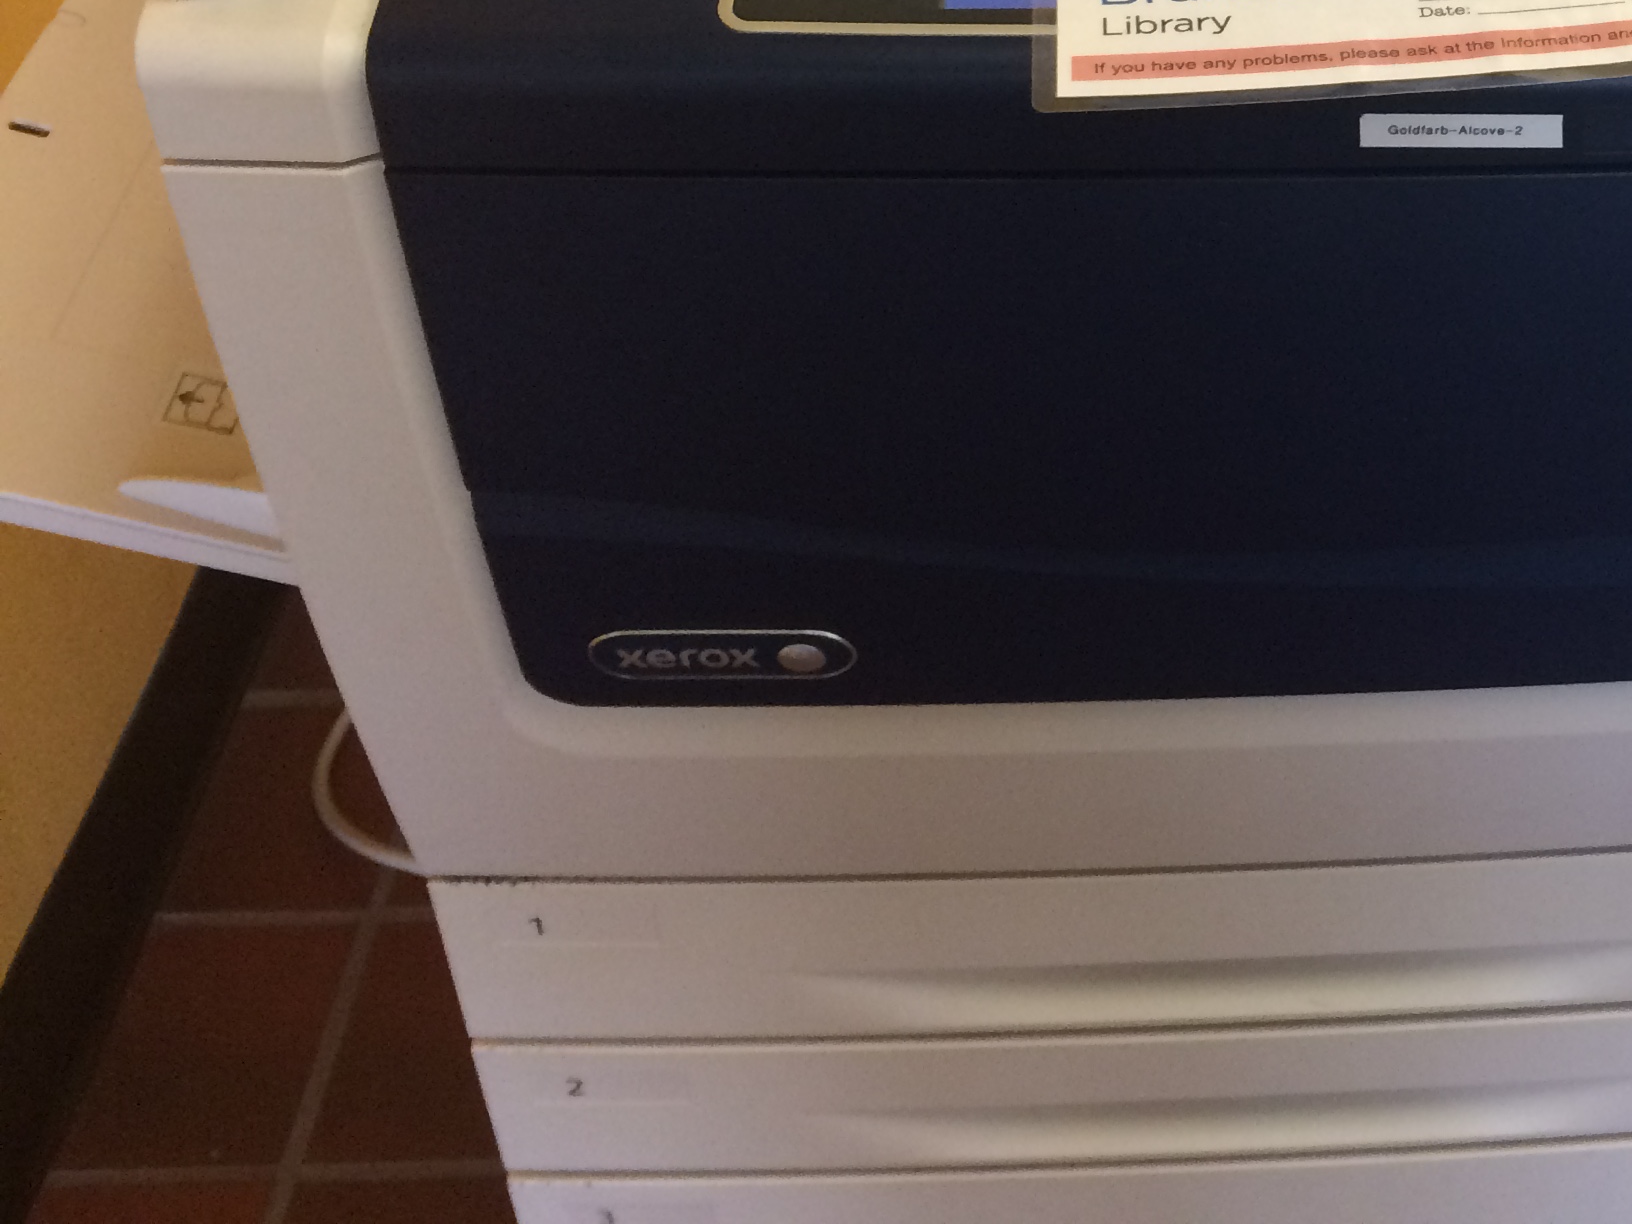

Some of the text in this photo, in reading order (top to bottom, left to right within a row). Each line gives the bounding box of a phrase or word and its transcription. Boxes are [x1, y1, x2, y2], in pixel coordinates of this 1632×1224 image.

[1417, 4, 1471, 19] Date:
[1102, 13, 1232, 36] Library
[1094, 62, 1105, 74] If
[1111, 61, 1145, 76] you
[1151, 57, 1197, 72] have
[1203, 55, 1237, 71] any
[1243, 50, 1333, 69] problems,
[1340, 46, 1400, 62] please
[1406, 44, 1438, 57] ask
[1444, 41, 1462, 54] at
[1465, 38, 1495, 52] the
[1501, 31, 1602, 49] Information
[1387, 124, 1524, 136] Goldfarb-Alcove-2
[617, 648, 760, 669] xerox
[528, 917, 545, 937] 1
[565, 1076, 585, 1098] 2
